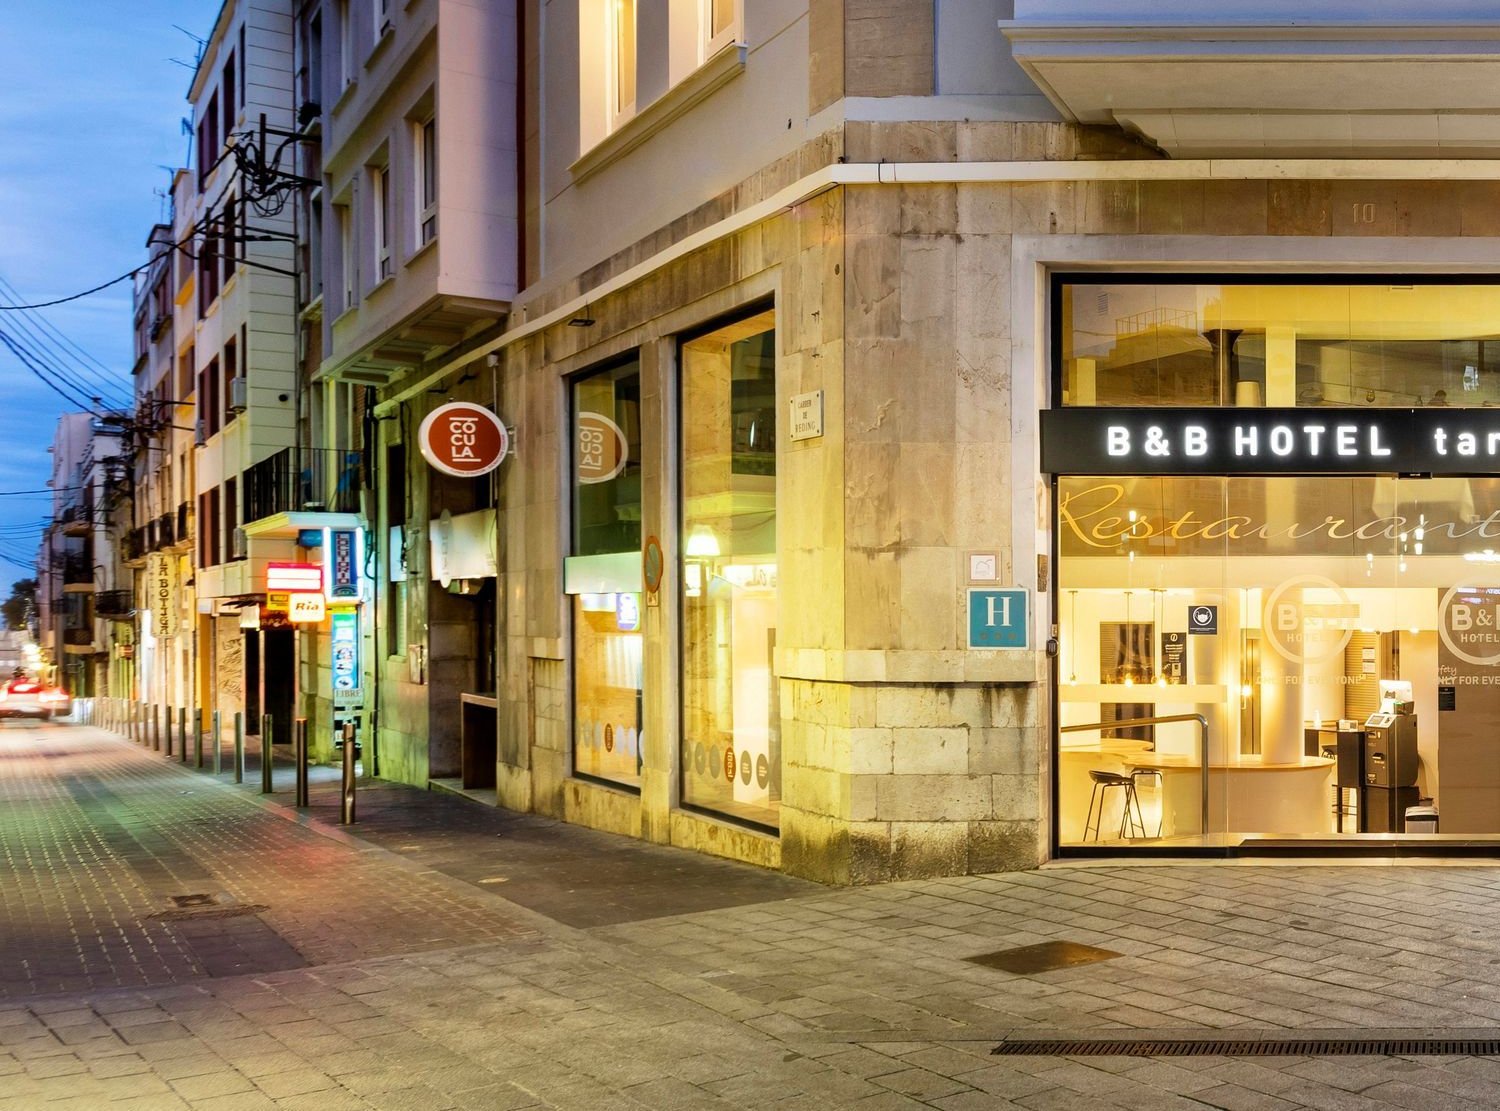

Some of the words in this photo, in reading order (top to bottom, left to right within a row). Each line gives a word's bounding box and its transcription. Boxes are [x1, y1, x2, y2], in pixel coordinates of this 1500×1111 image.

[1107, 425, 1208, 457] B&B
[1234, 425, 1392, 457] HOTEL
[295, 600, 320, 611] Ria
[984, 595, 1013, 627] H
[1459, 675, 1479, 685] FOR
